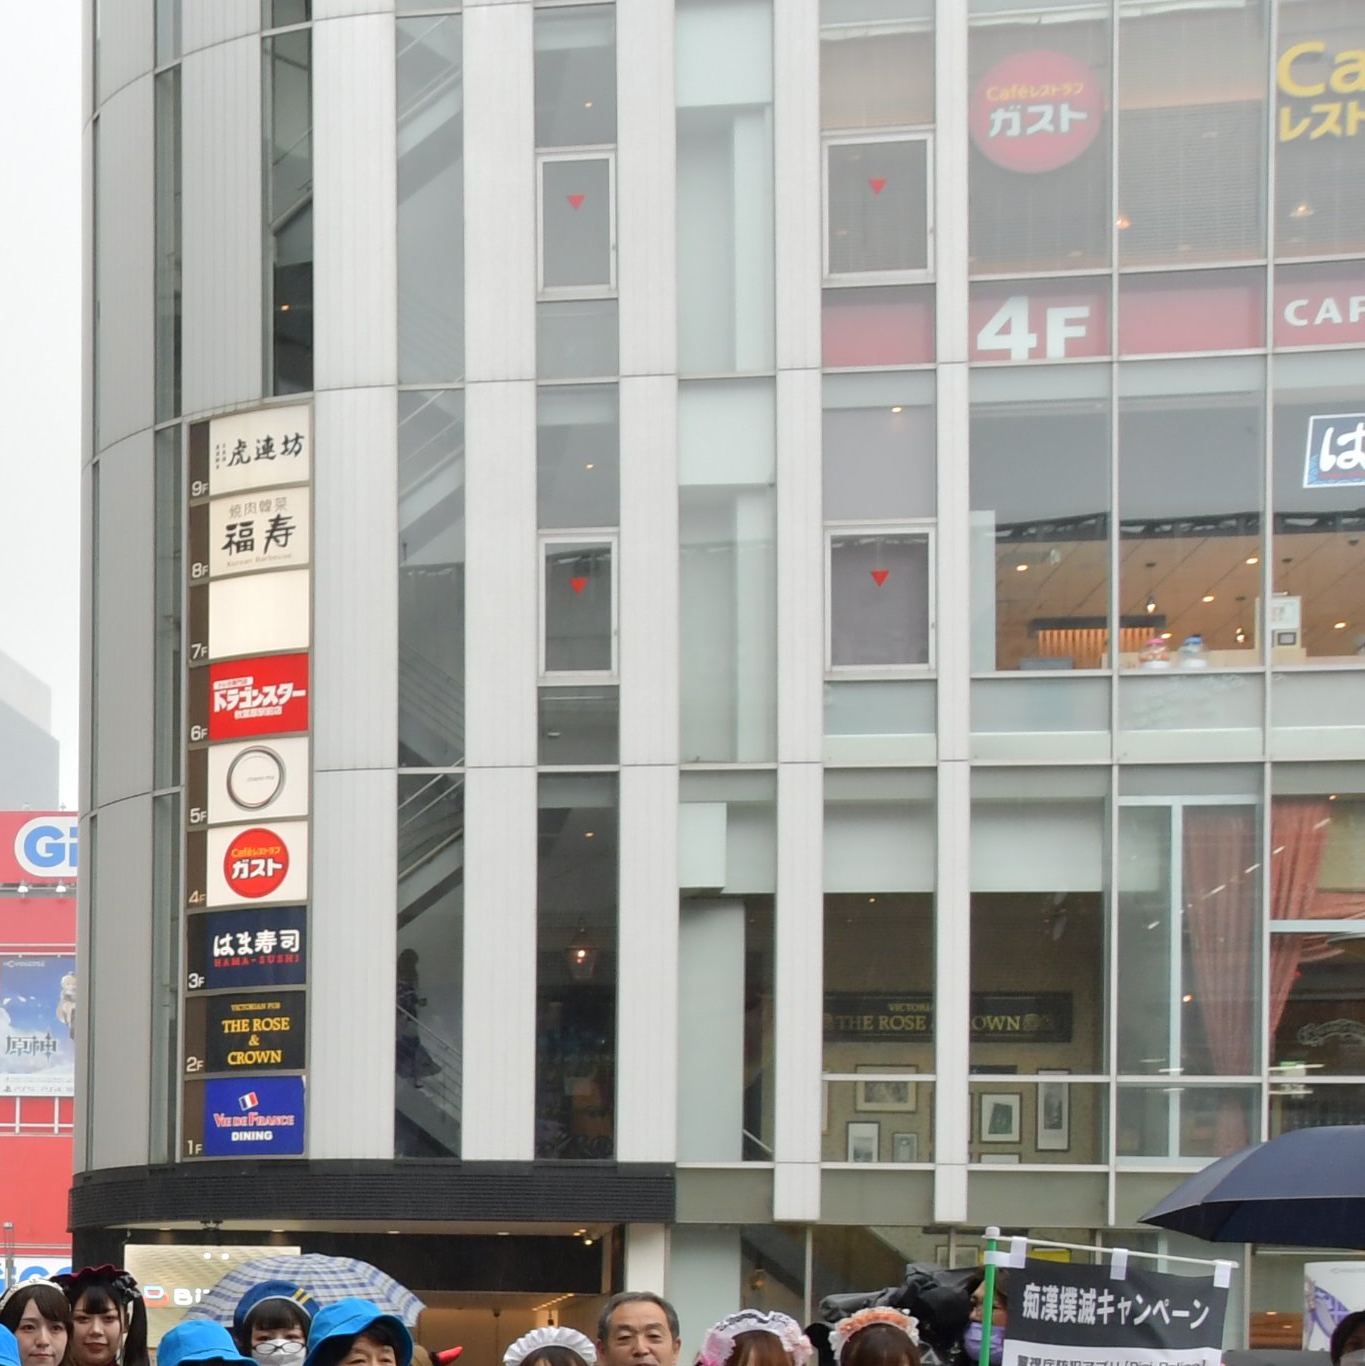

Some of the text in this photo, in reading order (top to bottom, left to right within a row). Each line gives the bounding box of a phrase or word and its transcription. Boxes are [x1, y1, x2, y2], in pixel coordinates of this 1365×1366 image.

[988, 103, 1089, 138] ガスト
[976, 295, 1091, 361] 4F
[192, 481, 208, 496] 9F
[221, 513, 296, 556] 福寿
[192, 562, 208, 578] 8F
[191, 643, 207, 659] 7F
[213, 682, 306, 713] ドラゴンスター
[190, 725, 208, 741] 6F
[190, 807, 208, 824] 5F
[231, 858, 283, 880] ガスト
[188, 890, 206, 904] 4F
[213, 929, 300, 957] はま寿司
[213, 954, 300, 968] HAMA-SUSHI
[188, 973, 206, 988] 3F
[221, 1017, 290, 1033] THE ROSE
[835, 1015, 874, 1031] THE
[878, 1015, 926, 1031] ROSE
[248, 1034, 260, 1046] &
[5, 1034, 57, 1063] 原神
[186, 1056, 204, 1072] 2F
[227, 1050, 282, 1065] CROWN
[231, 1131, 274, 1142] DINING
[187, 1139, 203, 1155] 1F
[1022, 1282, 1210, 1330] 痴漢撲滅キャンペーン
